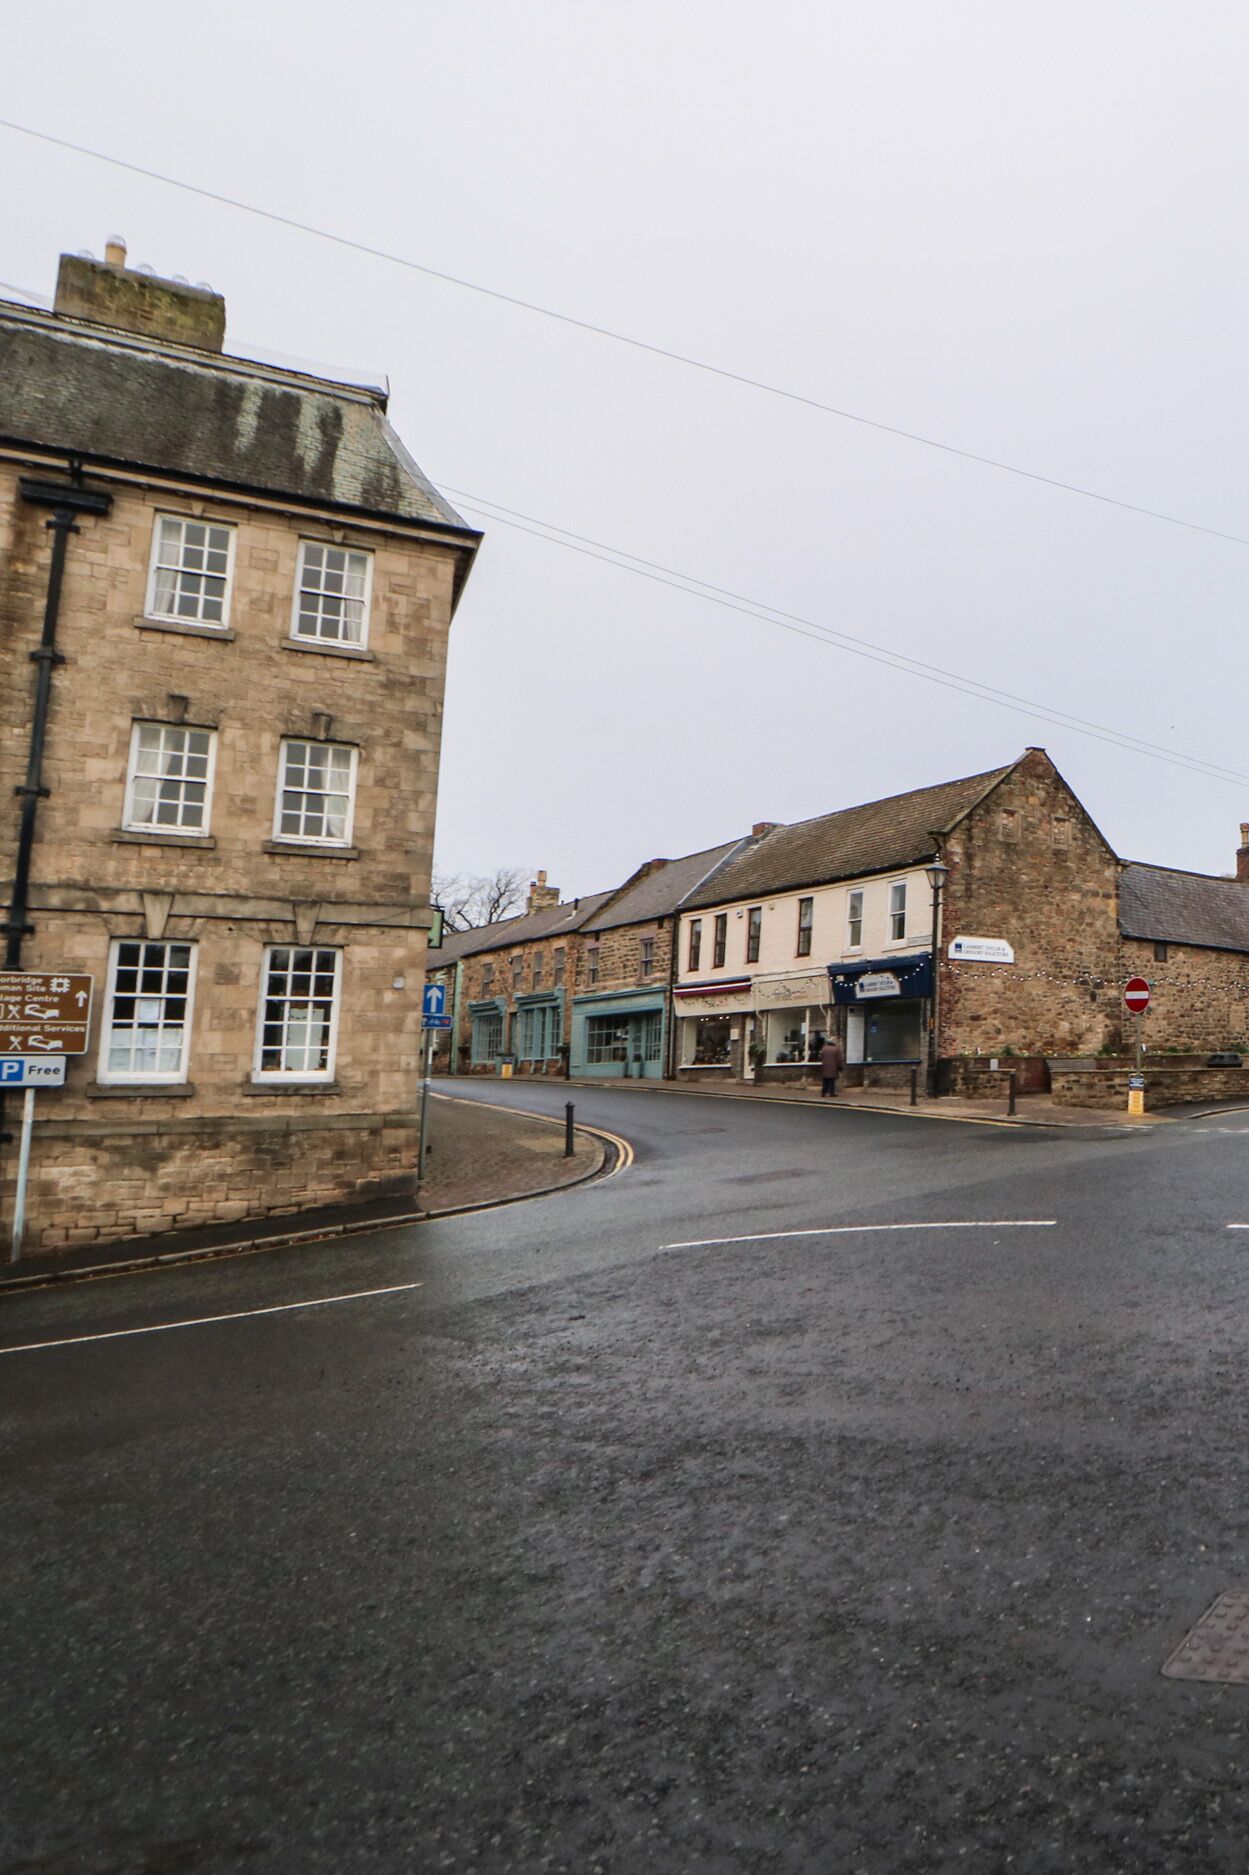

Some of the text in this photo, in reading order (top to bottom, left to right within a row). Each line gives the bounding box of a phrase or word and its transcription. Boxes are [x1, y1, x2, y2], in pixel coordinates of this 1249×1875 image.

[0, 976, 43, 985] orbridge
[25, 994, 60, 1003] Centre
[44, 1024, 86, 1033] Services
[1, 1062, 61, 1080] P Free
